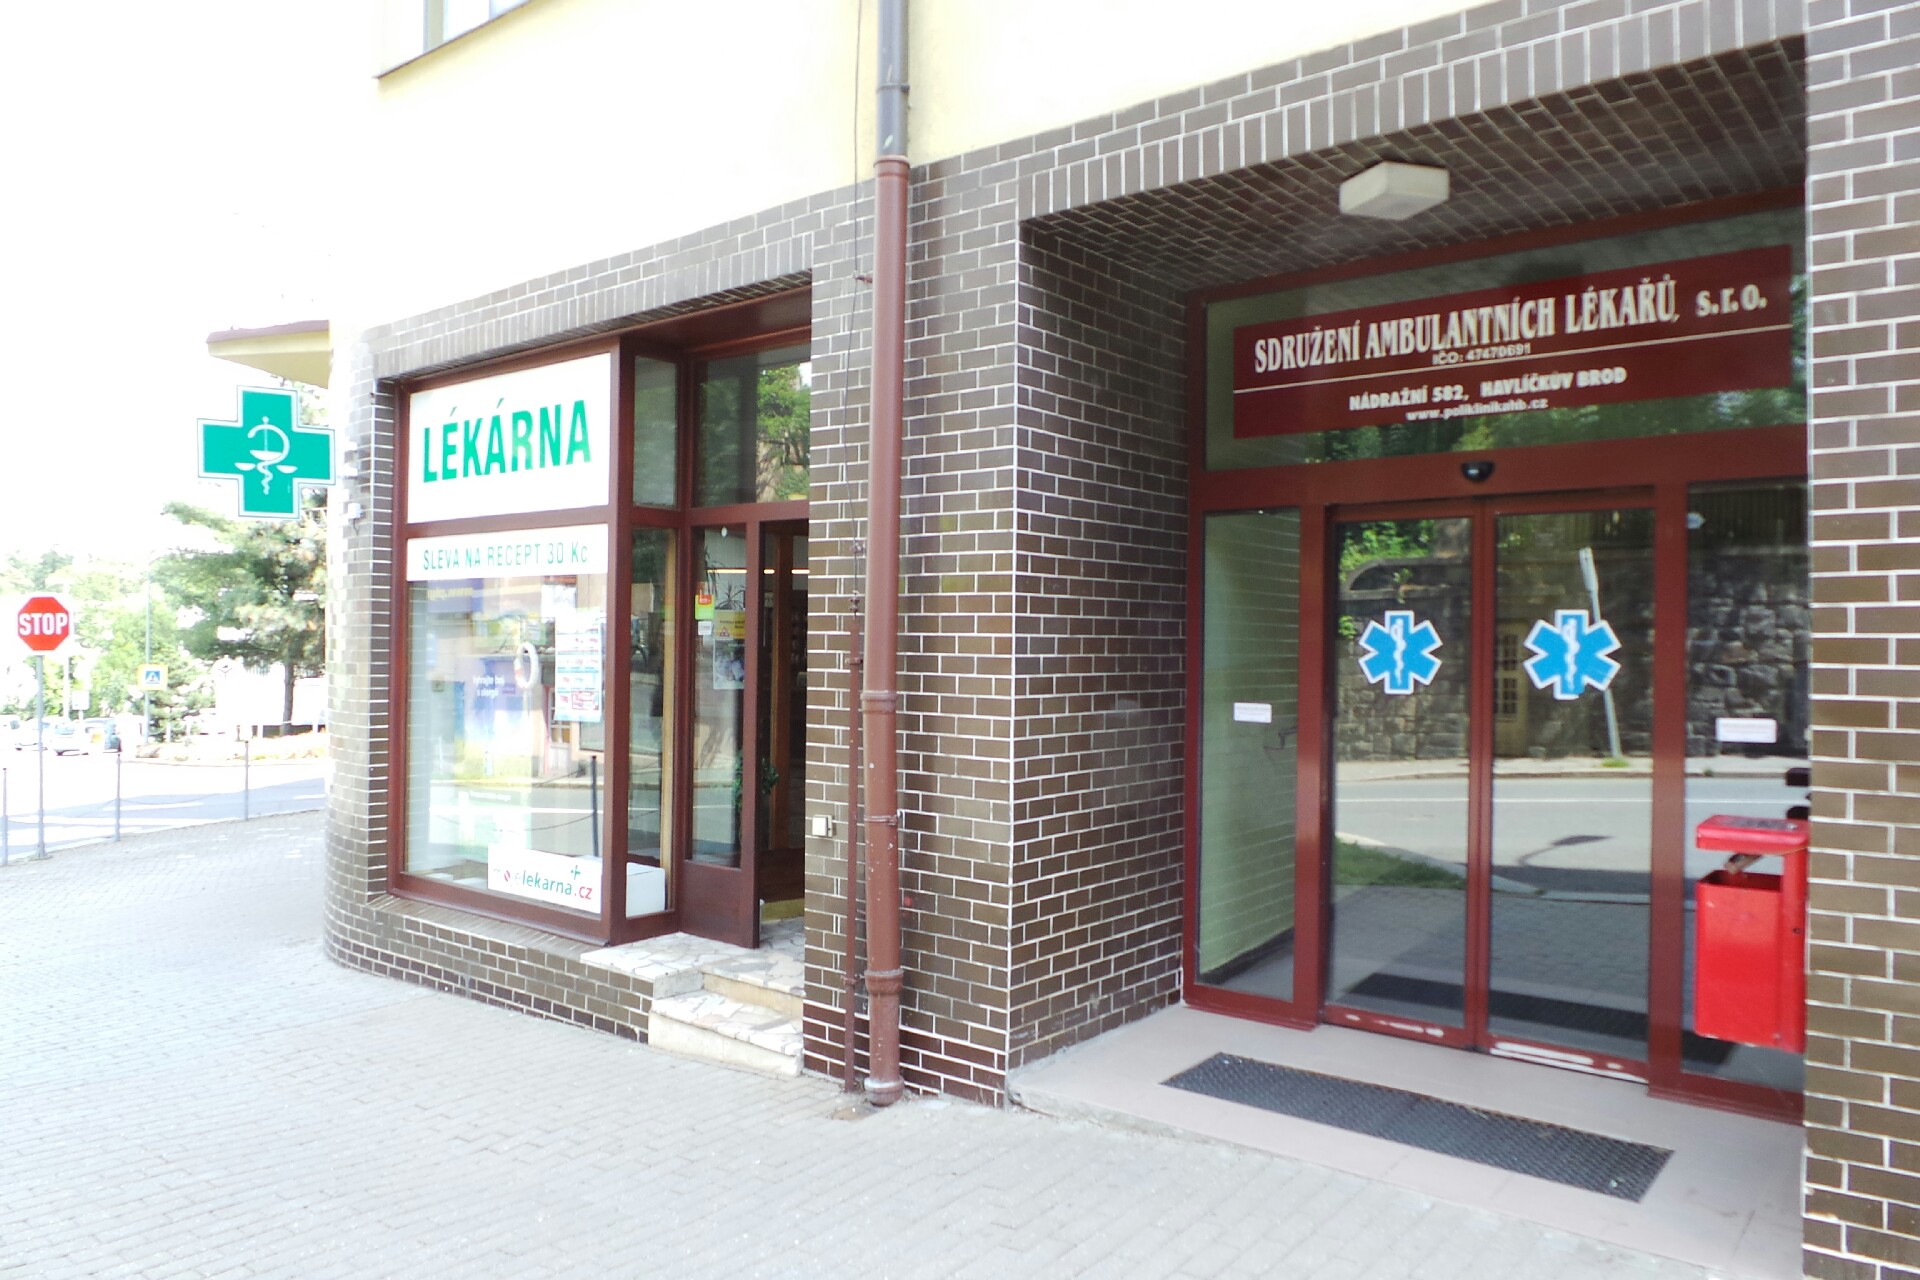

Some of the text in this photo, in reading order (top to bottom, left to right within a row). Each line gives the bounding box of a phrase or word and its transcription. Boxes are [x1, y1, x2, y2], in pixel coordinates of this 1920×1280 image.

[1254, 319, 1361, 374] SDRUŽENÍ
[1364, 296, 1557, 359] AMBULANTNÍCH
[1695, 284, 1768, 318] s.r.o.
[1348, 384, 1429, 411] NÁDRAŽNÍ
[1432, 383, 1469, 405] 582,
[1576, 366, 1628, 388] BROD
[423, 397, 592, 484] LÉKÁRNA
[423, 548, 460, 571] SLEVA
[465, 547, 481, 568] NA
[487, 543, 541, 567] RECEPT
[547, 541, 564, 565] 30
[18, 612, 68, 636] STOP
